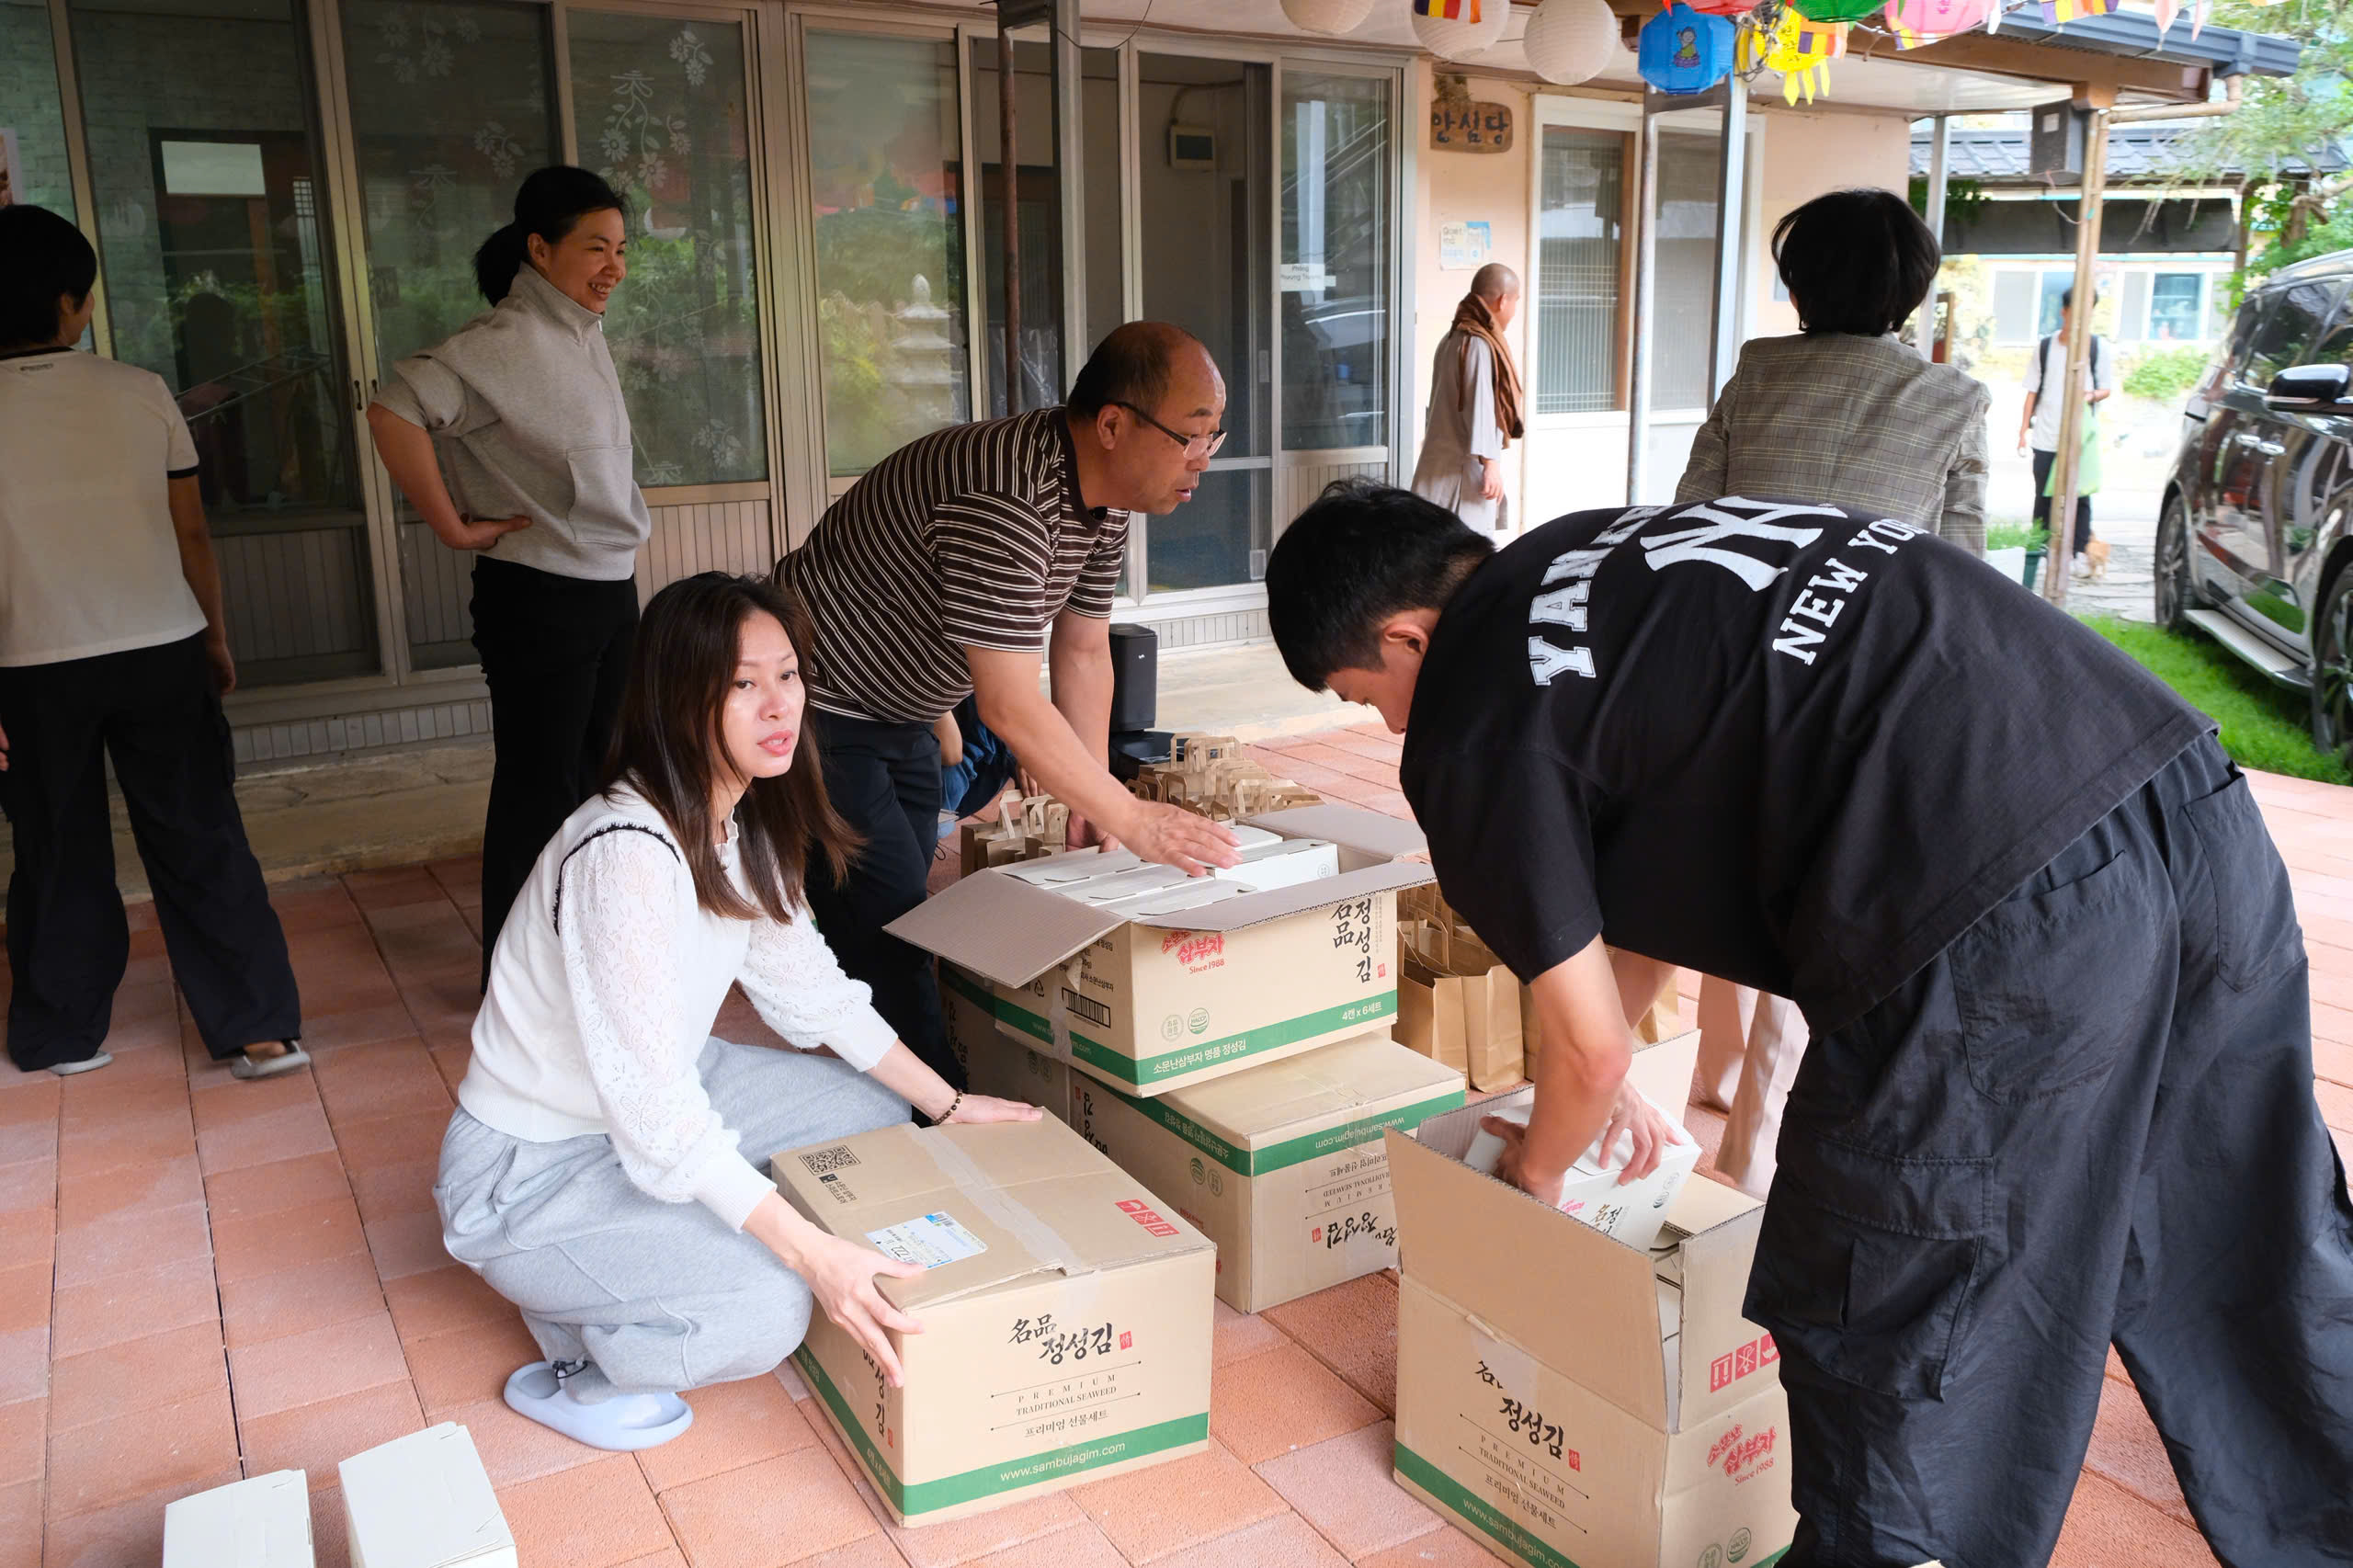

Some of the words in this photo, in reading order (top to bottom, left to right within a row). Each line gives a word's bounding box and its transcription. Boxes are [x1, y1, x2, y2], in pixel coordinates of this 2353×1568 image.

[1431, 109, 1508, 144] 안심당
[1772, 557, 1868, 665] NEW
[1847, 518, 1929, 554] YOR
[1176, 933, 1226, 965] 삼부자
[1209, 959, 1225, 970] 1988
[1362, 1001, 1382, 1016] 6세트
[1153, 1052, 1203, 1074] 소문난삼부자
[1204, 1046, 1222, 1061] 명품
[1222, 1040, 1246, 1054] 정성김
[1324, 1183, 1390, 1207] REMIUM
[1354, 1172, 1390, 1188] RADITIONAL
[1326, 1211, 1378, 1249] 정성김
[1007, 1313, 1057, 1344] 名品
[1039, 1323, 1113, 1365] 정성김
[1016, 1396, 1075, 1416] TRADITIONAL
[1076, 1386, 1117, 1403] SEAWEED
[1018, 1375, 1116, 1403] PREMIUM
[1024, 1419, 1066, 1437] 프리미엄
[1068, 1409, 1108, 1427] 선물세트
[1499, 1397, 1564, 1460] 정성김
[1000, 1442, 1126, 1482] www.sambujagim.com
[1481, 1435, 1564, 1495] PREMIUM
[1722, 1426, 1777, 1476] 삼부자
[1479, 1448, 1529, 1484] TRADITIONAL
[1529, 1479, 1565, 1509] SEAWEED
[1735, 1471, 1755, 1485] Since
[1756, 1457, 1775, 1474] 1988
[1485, 1474, 1519, 1505] 프리미엄
[1521, 1498, 1557, 1529] 선물세트
[1463, 1498, 1564, 1568] www.sambujagim.co
